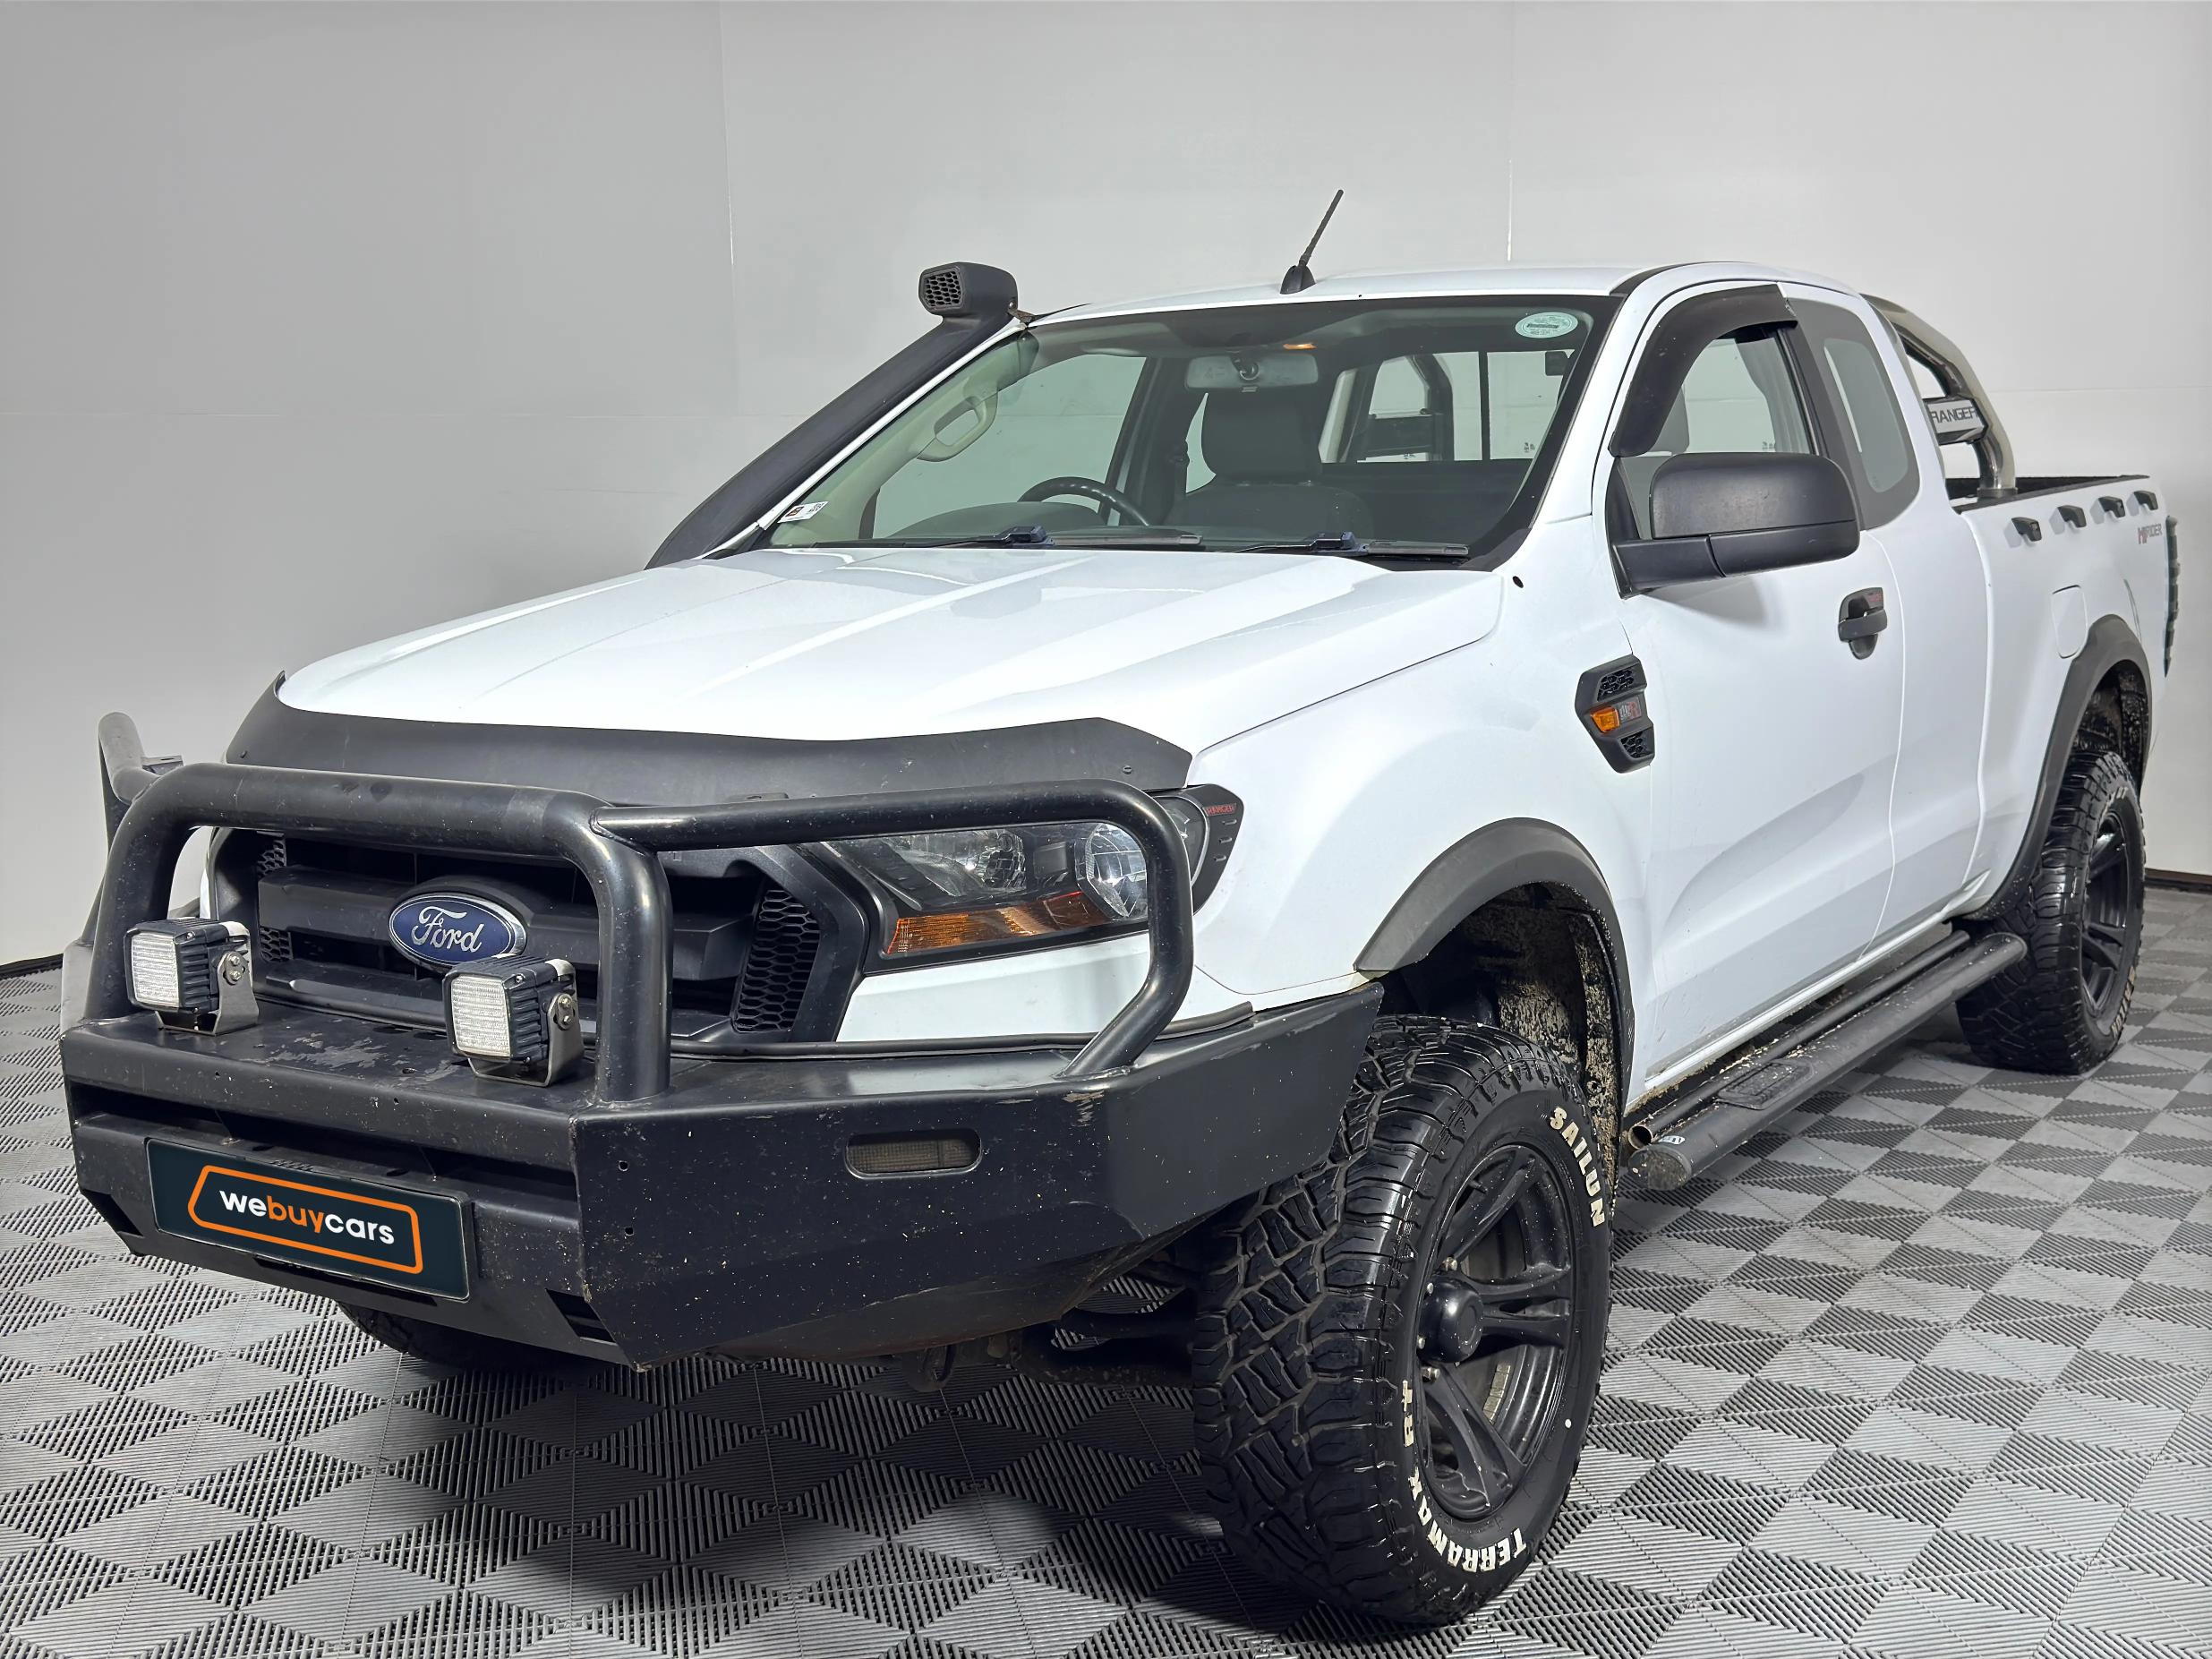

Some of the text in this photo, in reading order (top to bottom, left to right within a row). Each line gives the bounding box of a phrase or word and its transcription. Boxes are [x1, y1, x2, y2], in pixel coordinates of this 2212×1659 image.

[1930, 406, 1977, 423] RANGER
[411, 905, 485, 953] Ford
[1550, 1107, 1606, 1227] SAILUN
[219, 1189, 395, 1244] webuycars
[1407, 1466, 1527, 1573] TERRAMAX
